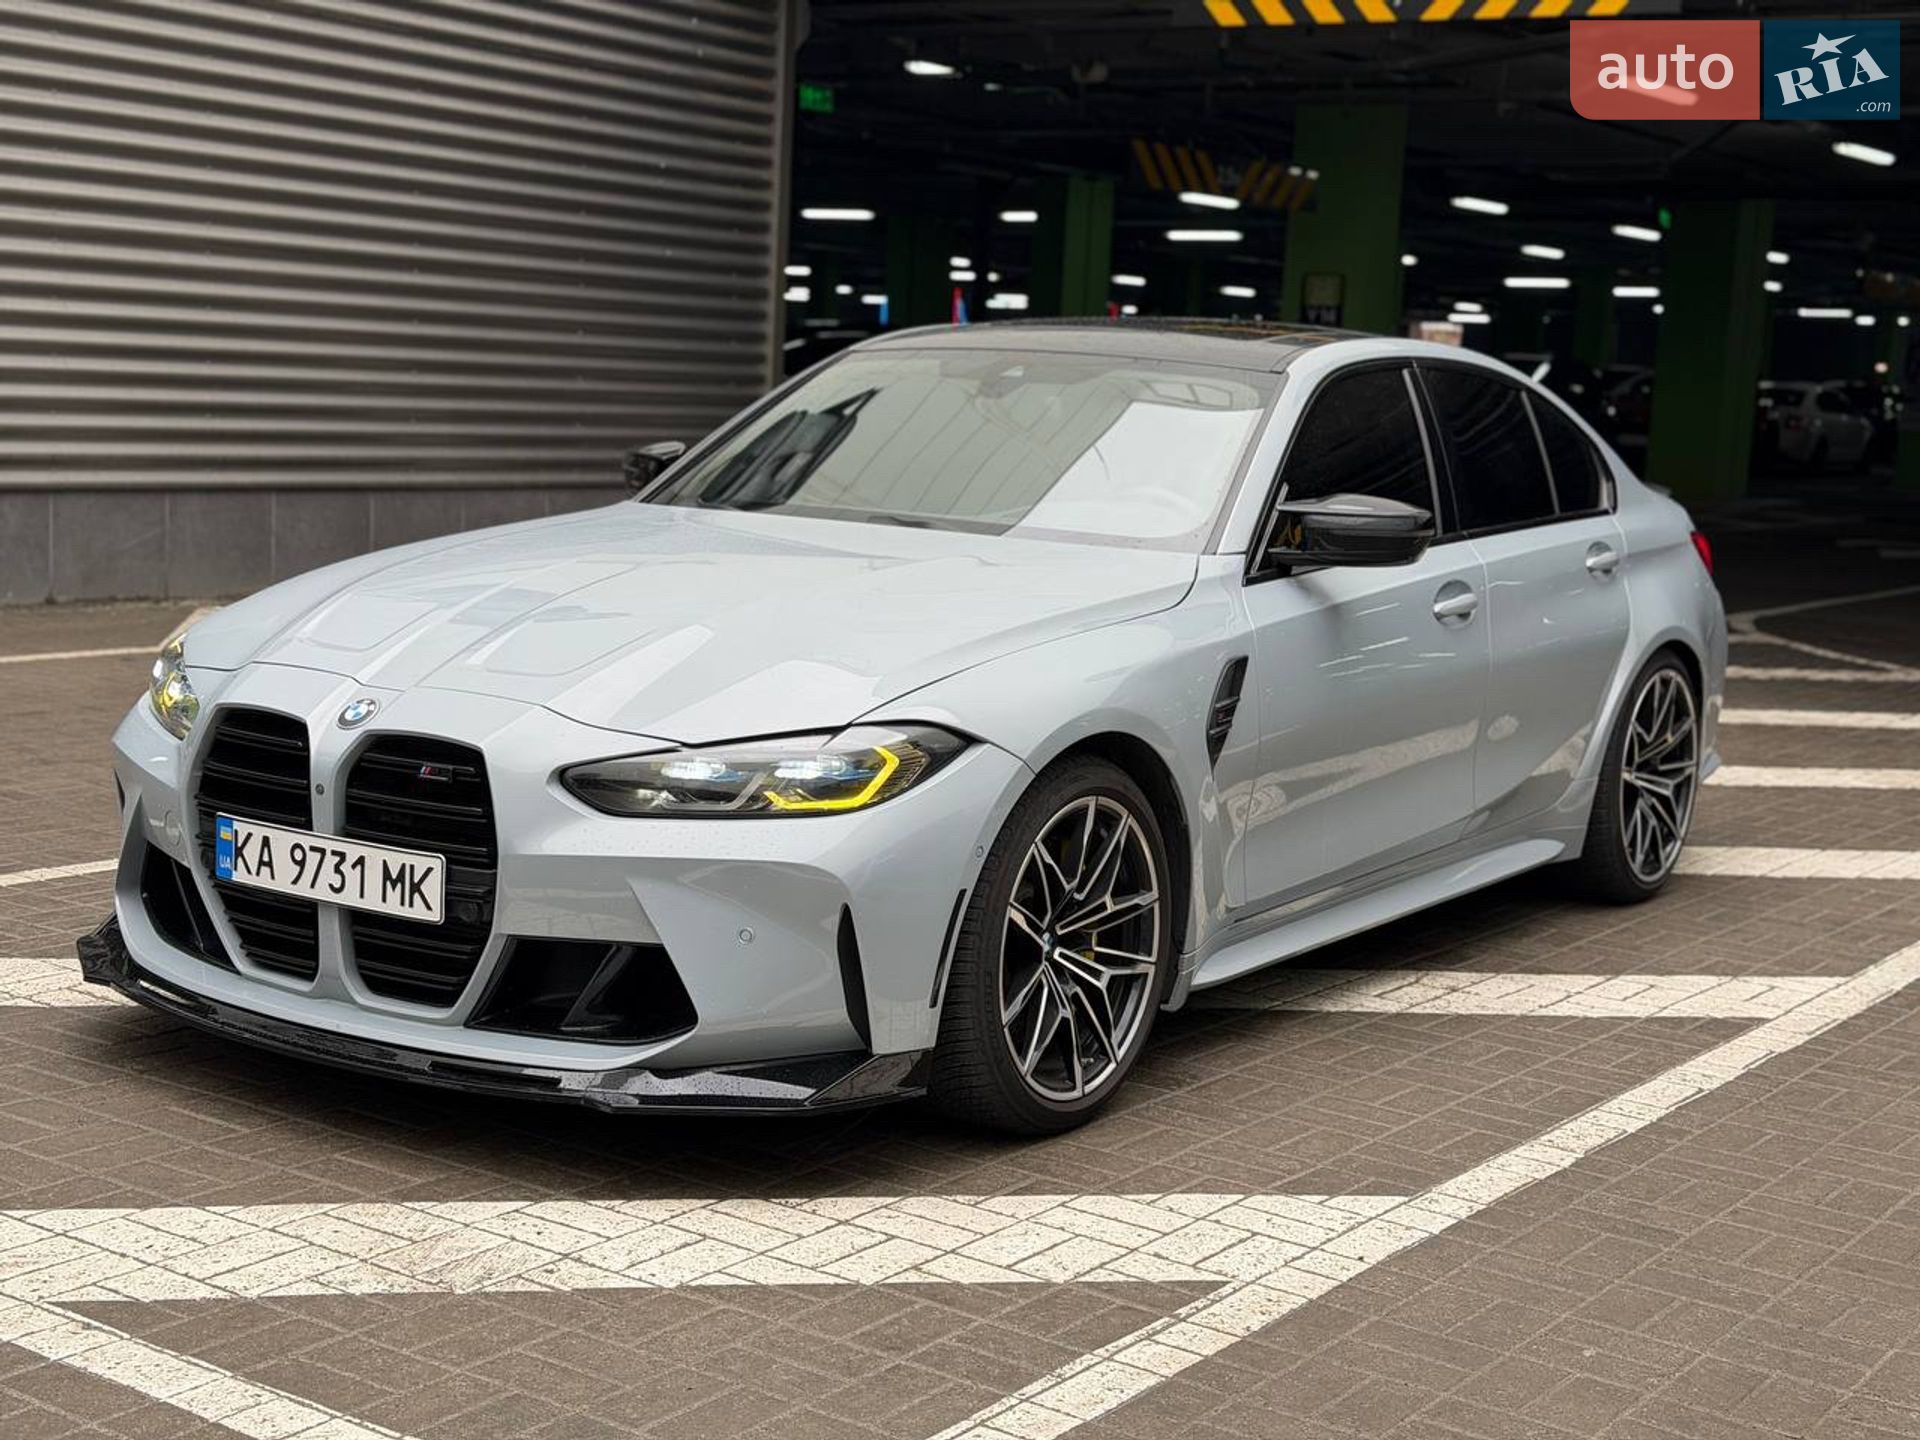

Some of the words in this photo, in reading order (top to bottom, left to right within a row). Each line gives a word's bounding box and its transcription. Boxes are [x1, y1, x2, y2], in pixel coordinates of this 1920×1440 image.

[219, 854, 231, 869] UA
[234, 829, 275, 880] KA
[290, 843, 366, 899] 9731
[382, 859, 435, 911] MK
